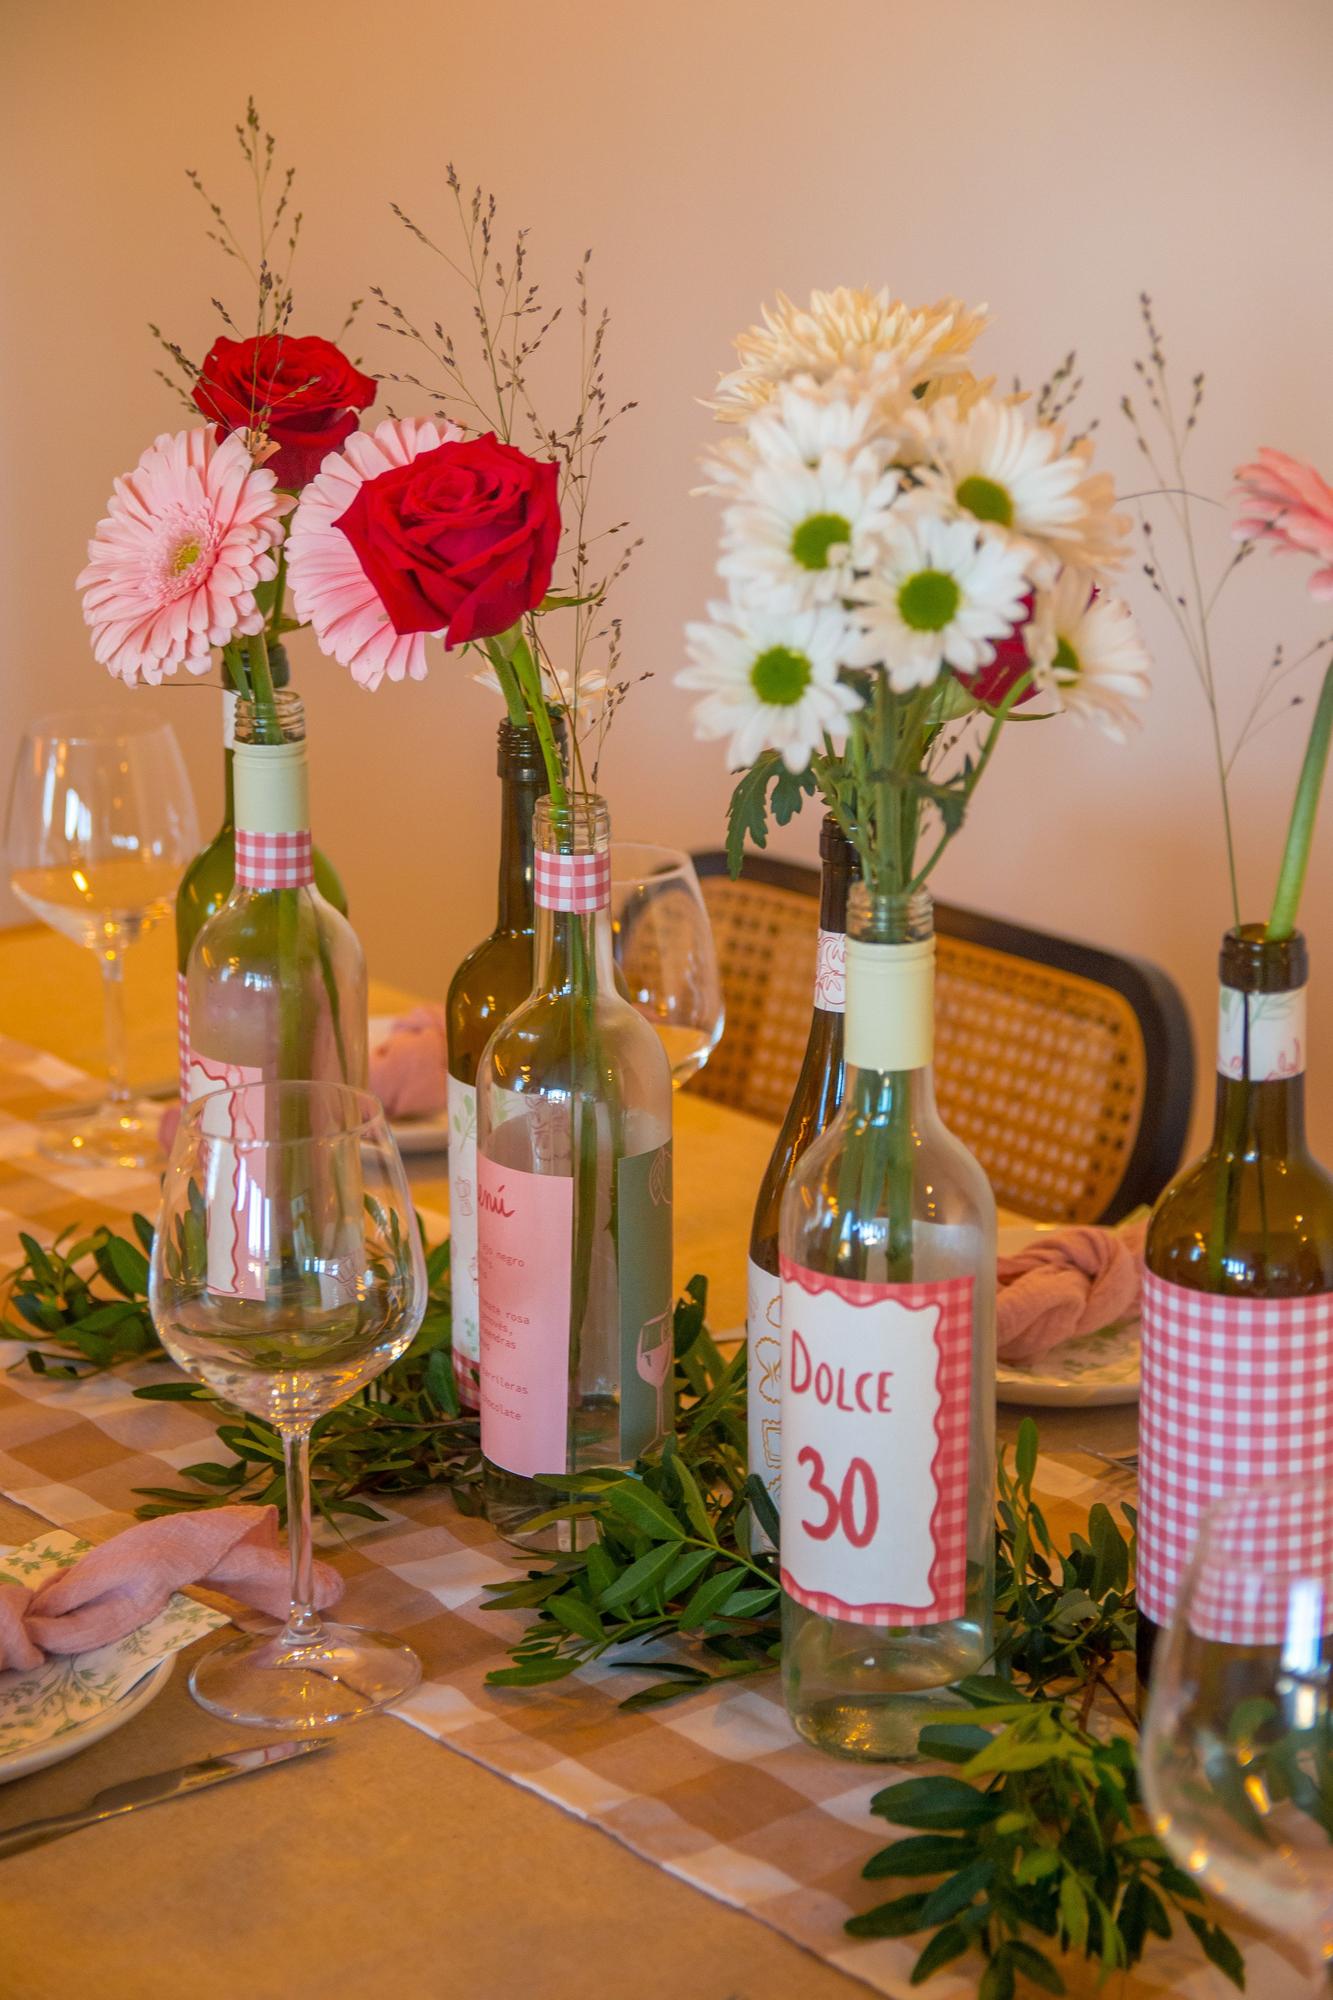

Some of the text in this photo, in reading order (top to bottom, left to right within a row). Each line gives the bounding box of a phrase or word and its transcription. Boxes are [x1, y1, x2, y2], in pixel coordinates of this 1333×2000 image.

[505, 1312, 530, 1325] rosa
[790, 1329, 894, 1413] DOLCE
[797, 1446, 879, 1548] 30
